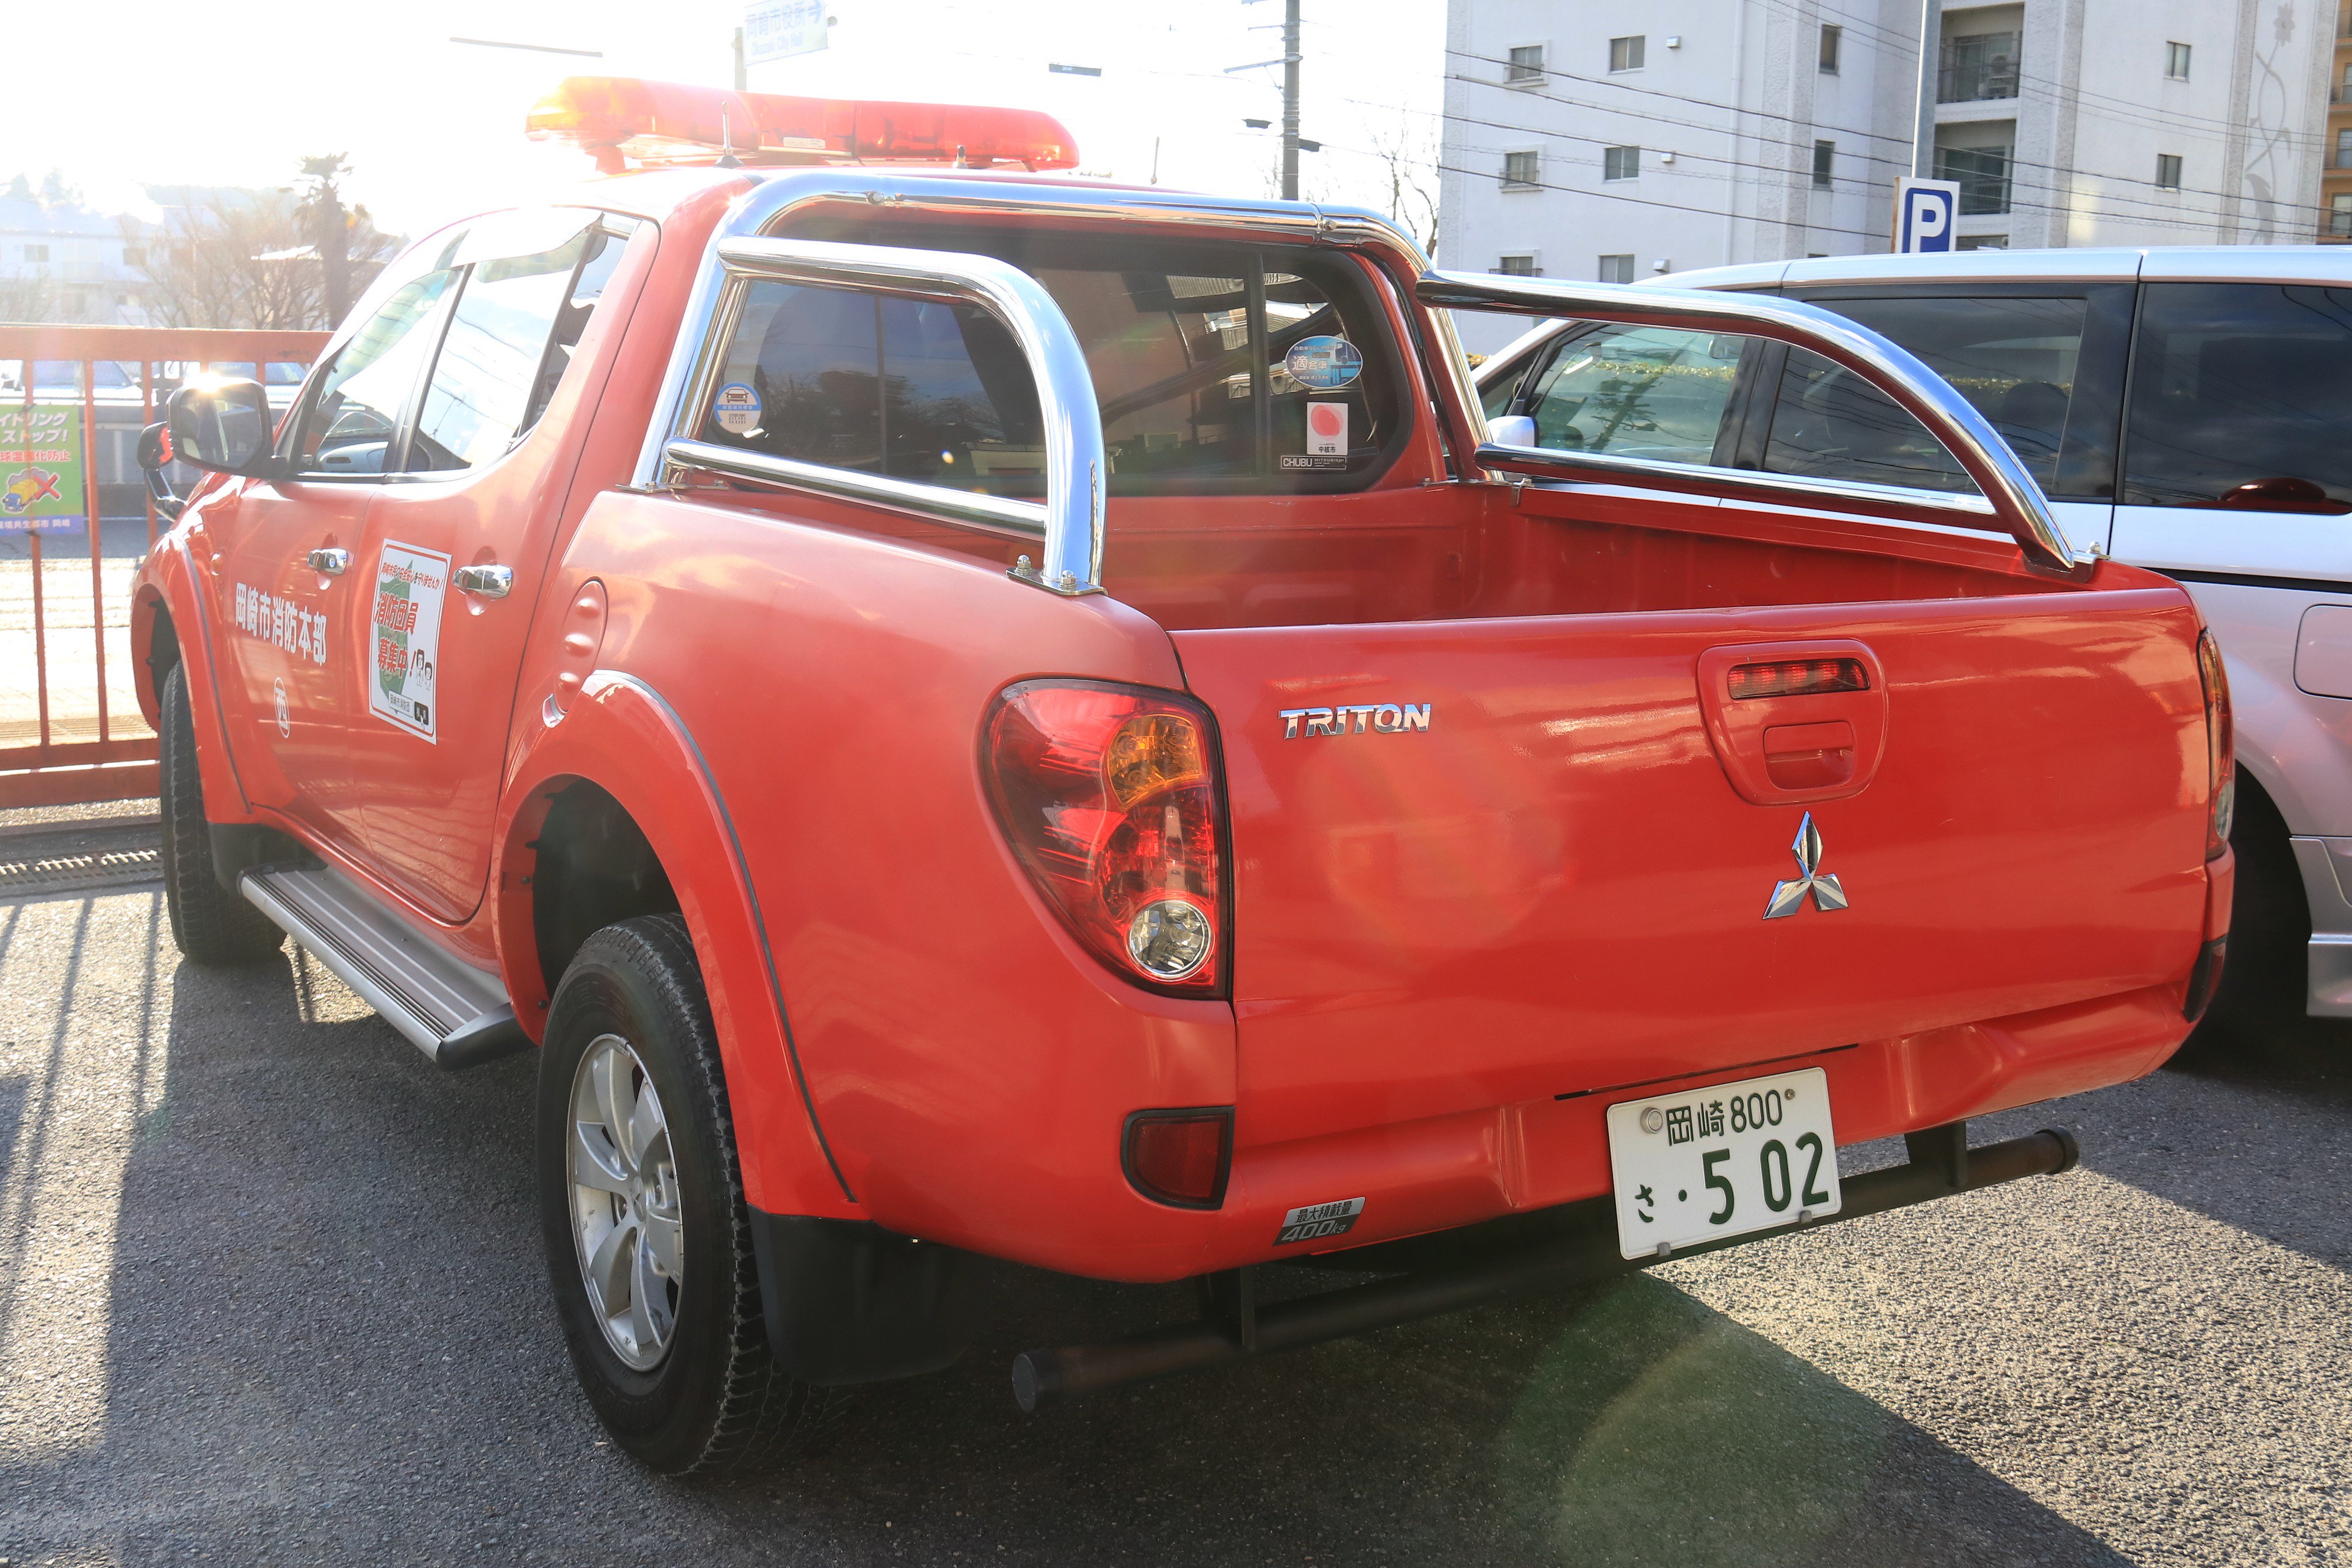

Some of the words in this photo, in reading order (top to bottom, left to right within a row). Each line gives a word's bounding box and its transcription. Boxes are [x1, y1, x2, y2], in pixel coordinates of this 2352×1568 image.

[1908, 192, 1946, 253] P
[1292, 355, 1328, 371] 適合車
[1283, 458, 1312, 467] CHUBU
[236, 582, 327, 667] 岡崎市消防本部
[374, 590, 419, 636] 消防団員
[1278, 703, 1431, 740] TRITON
[1295, 1200, 1353, 1223] 最大積載量
